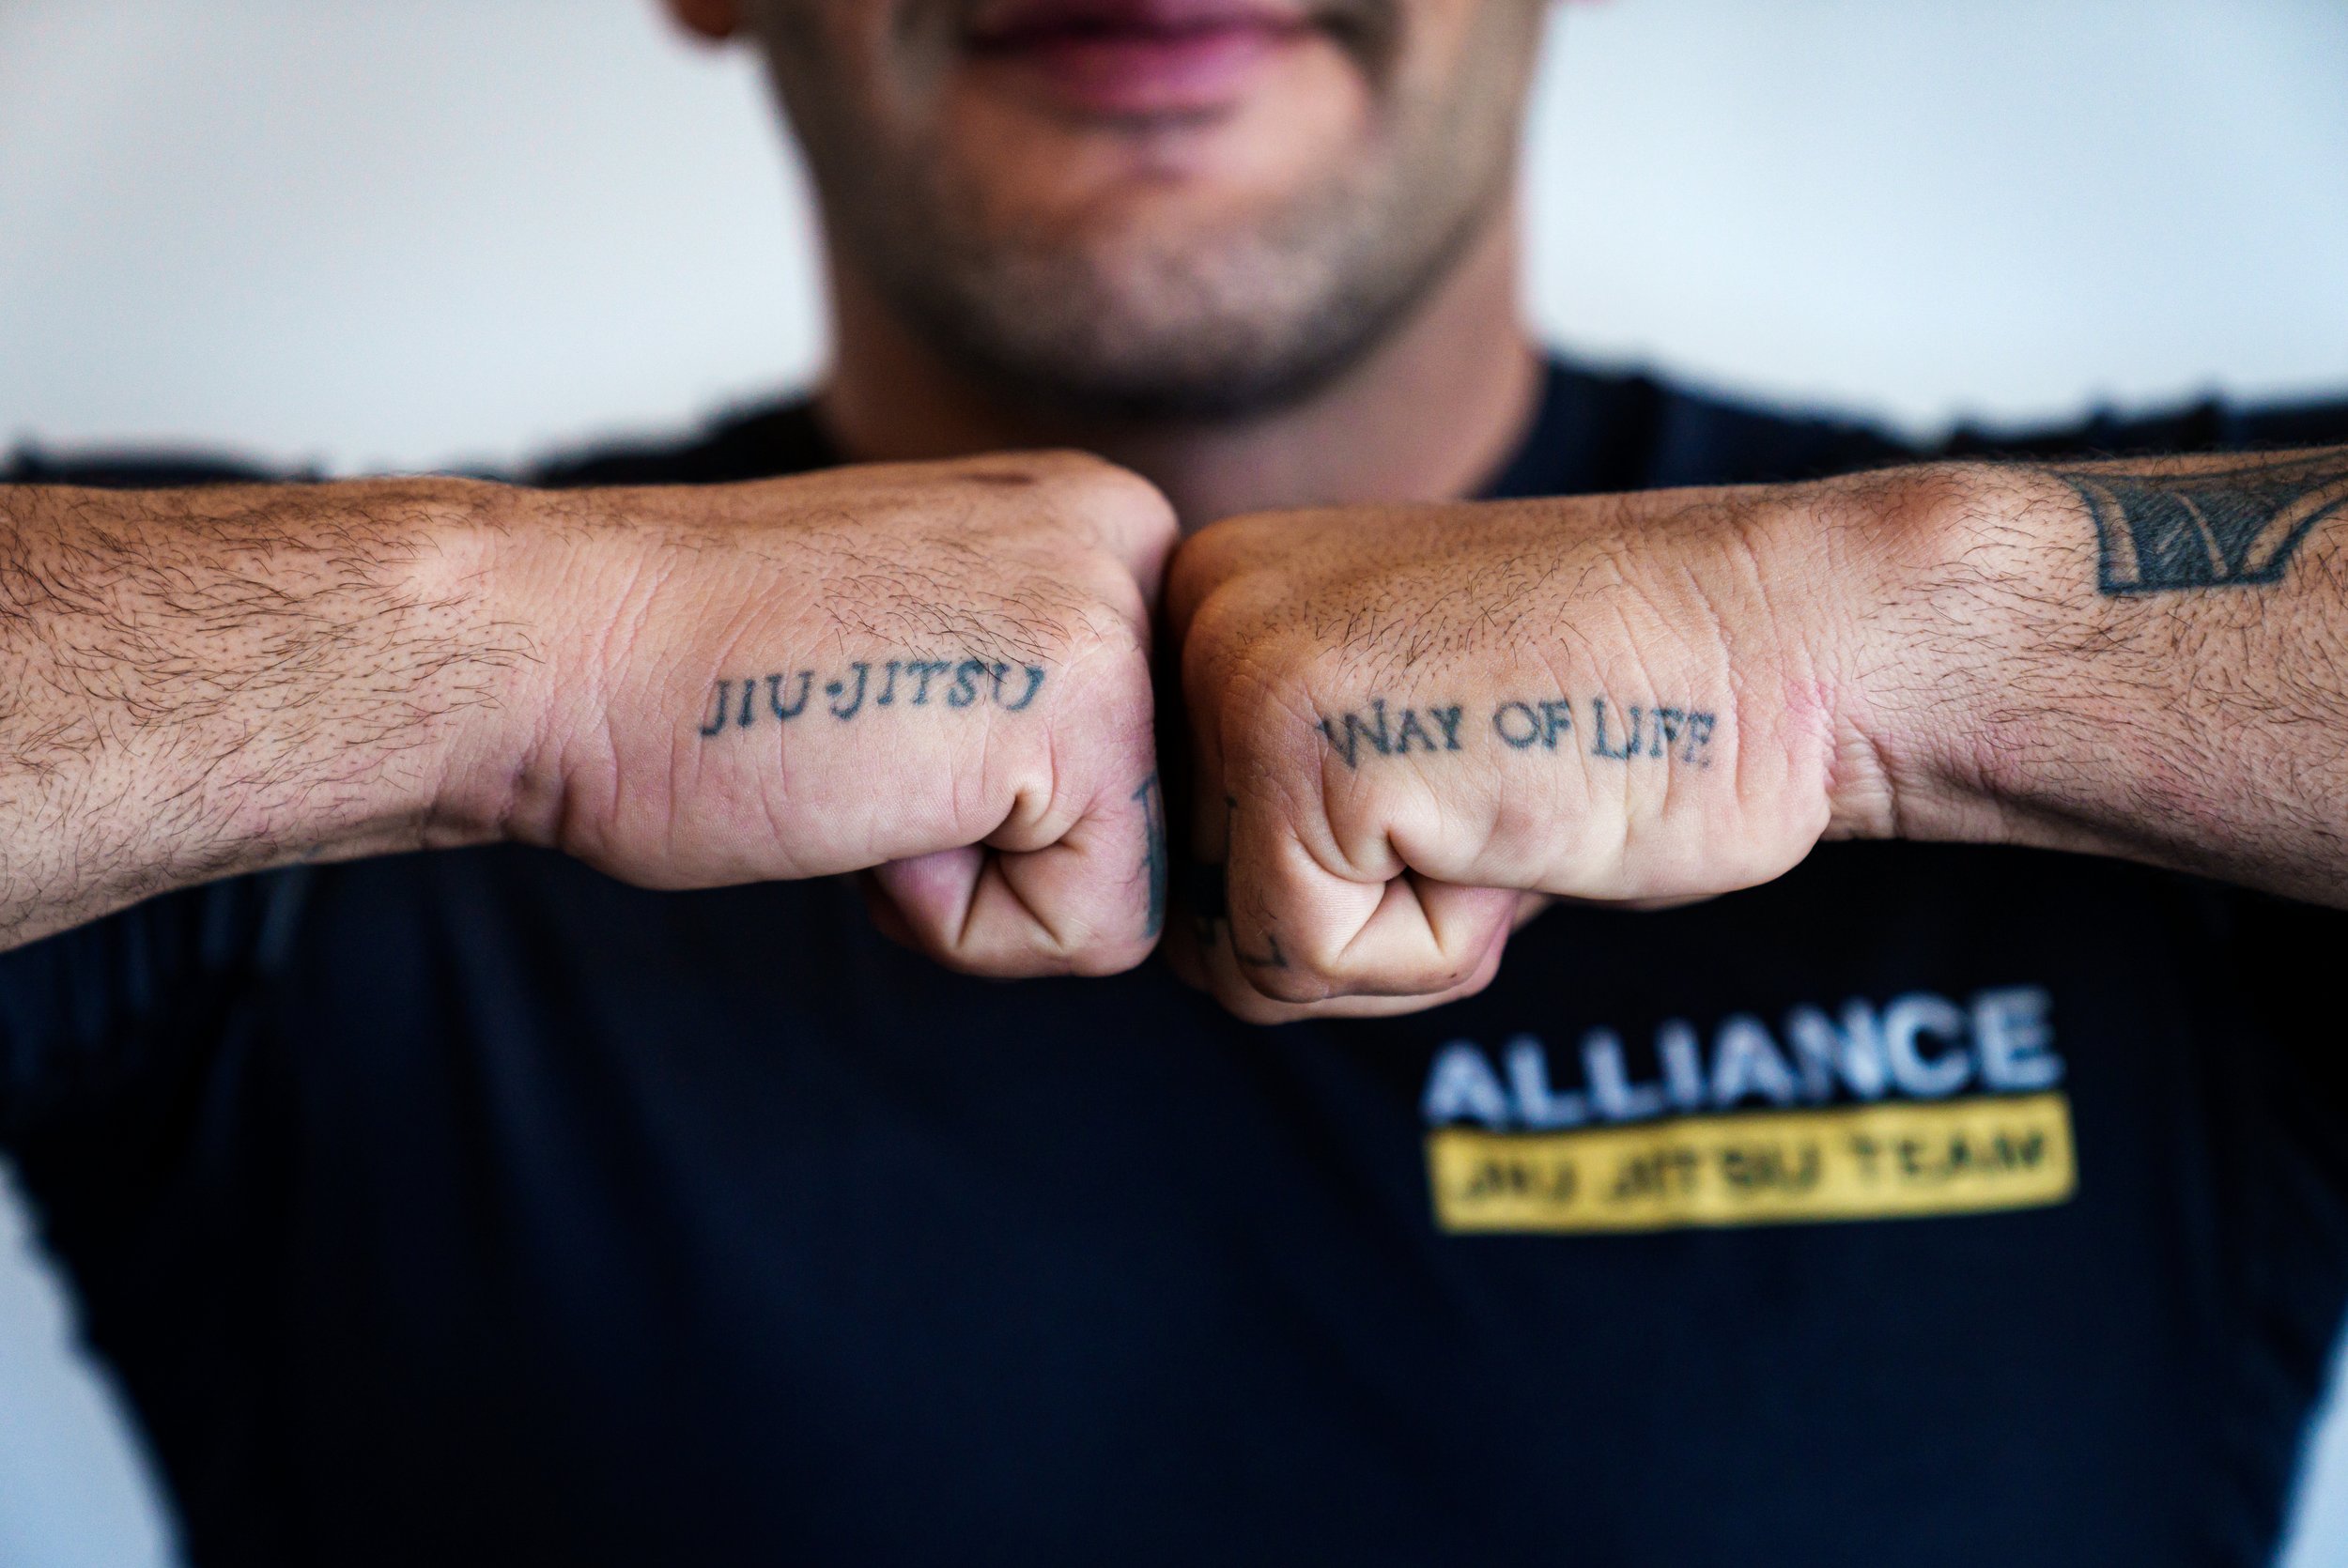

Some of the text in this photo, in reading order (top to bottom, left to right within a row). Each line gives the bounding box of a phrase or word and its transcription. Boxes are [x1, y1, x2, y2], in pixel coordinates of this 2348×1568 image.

[1316, 697, 1716, 770] WAY OF LIFE
[1421, 986, 2062, 1130] ALLIANCE
